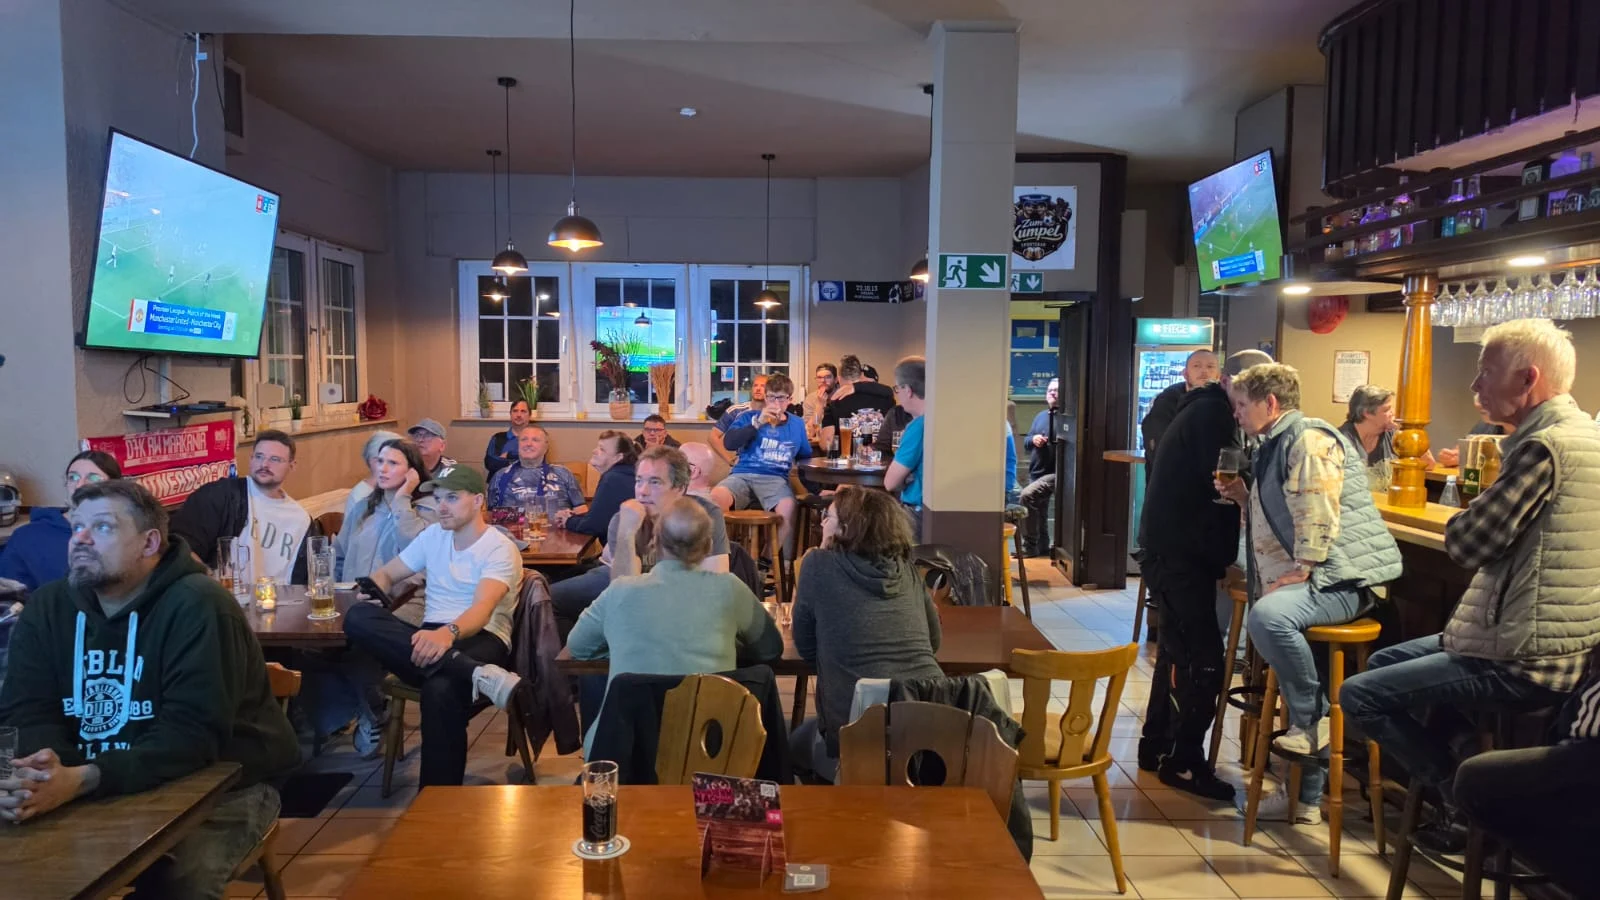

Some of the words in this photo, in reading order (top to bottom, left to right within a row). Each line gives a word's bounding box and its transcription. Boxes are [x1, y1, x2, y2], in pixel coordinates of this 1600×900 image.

[1022, 219, 1043, 228] Zum
[170, 307, 185, 316] League
[150, 313, 176, 324] Manchester
[175, 316, 189, 325] United
[84, 701, 114, 716] DUB
